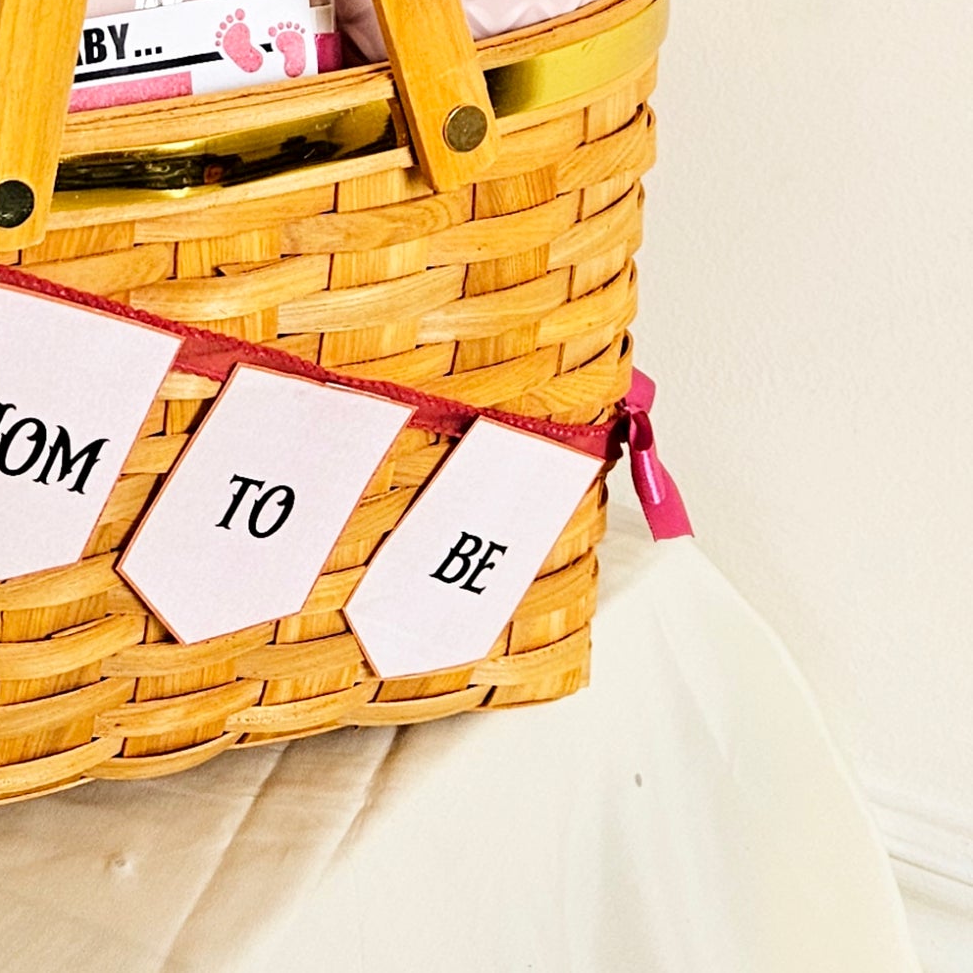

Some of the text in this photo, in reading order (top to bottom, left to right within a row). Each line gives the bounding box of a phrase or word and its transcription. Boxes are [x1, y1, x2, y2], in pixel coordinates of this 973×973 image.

[76, 23, 162, 66] BY...
[214, 473, 296, 539] TO
[429, 531, 507, 595] BE
